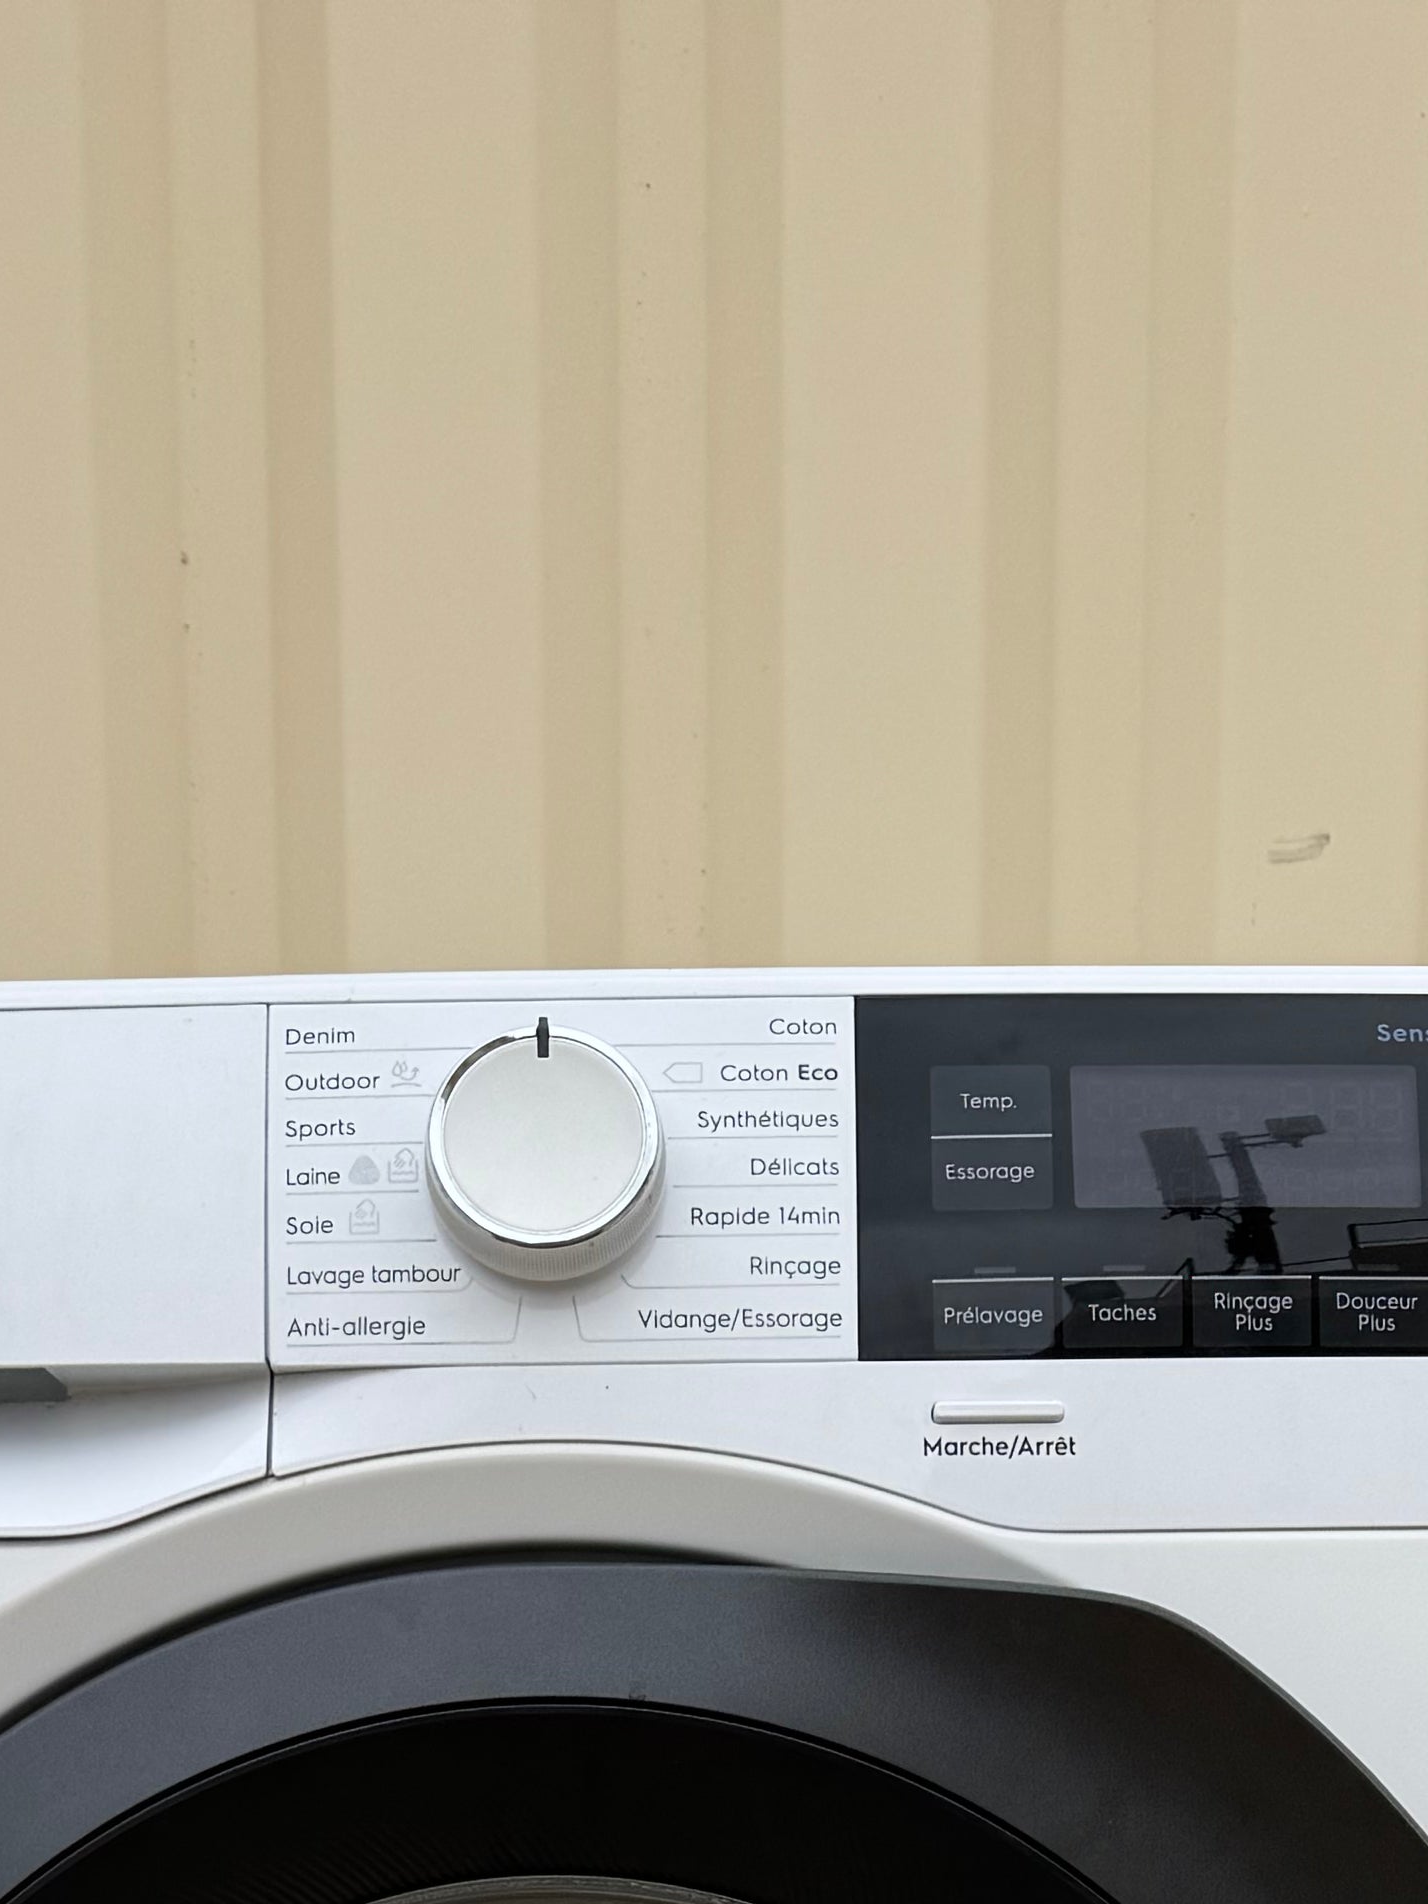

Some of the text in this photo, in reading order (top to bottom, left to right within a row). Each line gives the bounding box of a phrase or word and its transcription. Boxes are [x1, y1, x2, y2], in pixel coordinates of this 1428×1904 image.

[285, 1027, 355, 1046] Denim
[769, 1018, 837, 1035] Coton
[284, 1073, 381, 1092] Outdoor
[720, 1064, 839, 1082] Coton Eco
[959, 1093, 1017, 1112] Temp.
[285, 1119, 356, 1142] Sports
[697, 1110, 839, 1133] Synthétiques
[286, 1167, 341, 1186] Laine
[750, 1157, 840, 1176] Délicats
[945, 1163, 1035, 1183] Essorage
[285, 1215, 334, 1236] Soie
[690, 1206, 841, 1230] Rapide 14min
[287, 1264, 462, 1290] Lavage tambour
[750, 1255, 841, 1280] Rinçage
[1214, 1292, 1293, 1314] Rinçage
[1336, 1292, 1419, 1310] Douceur
[637, 1308, 843, 1334] Vidange/Essorage
[943, 1306, 1043, 1328] Prélavage
[1087, 1303, 1157, 1322] Taches
[1235, 1313, 1273, 1332] Plus
[1358, 1313, 1396, 1332] Plus
[287, 1315, 426, 1341] Anti-allergie
[923, 1434, 1076, 1460] Marche/Arrêt
